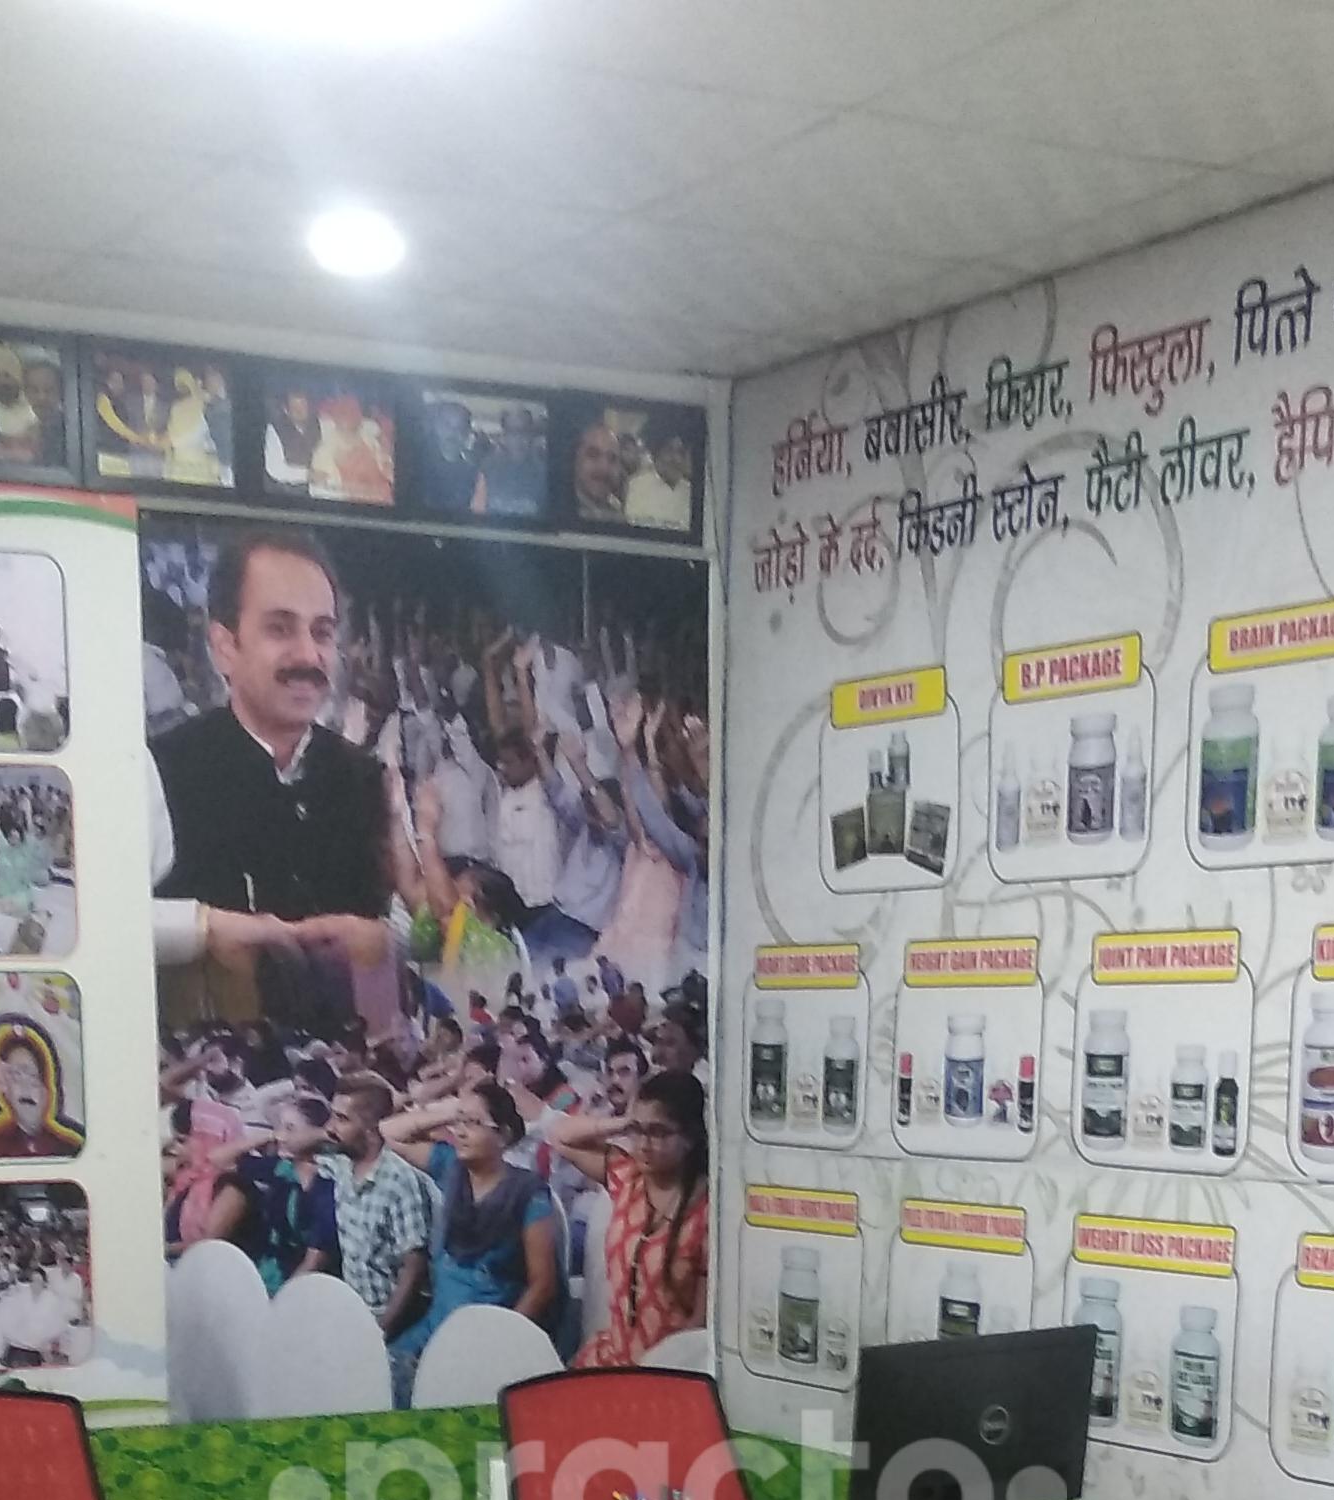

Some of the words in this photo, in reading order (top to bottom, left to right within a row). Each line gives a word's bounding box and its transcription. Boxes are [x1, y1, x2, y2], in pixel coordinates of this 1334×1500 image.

[897, 473, 983, 560] किडनी
[1085, 429, 1148, 515] फैटी
[1160, 415, 1255, 505] लीवर,
[1229, 624, 1274, 654] BRAIN
[1021, 661, 1046, 689] B.P
[1049, 648, 1122, 685] PACKAGE
